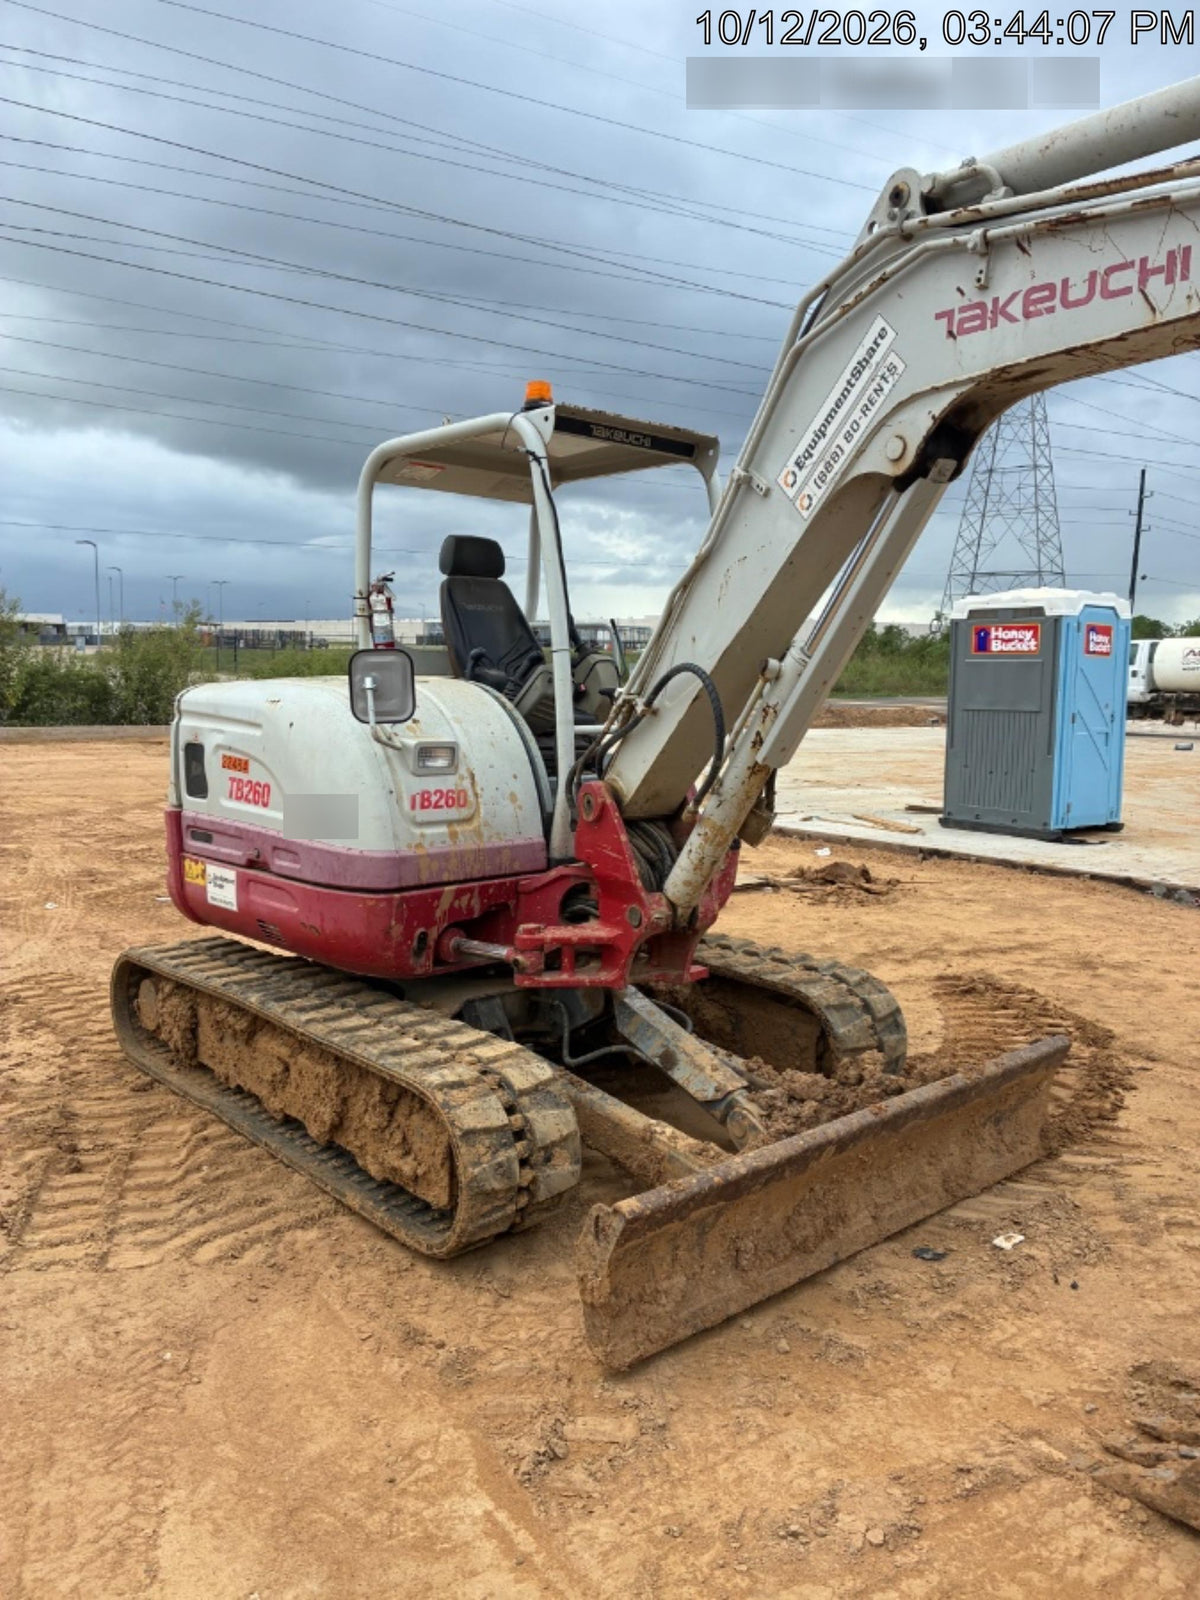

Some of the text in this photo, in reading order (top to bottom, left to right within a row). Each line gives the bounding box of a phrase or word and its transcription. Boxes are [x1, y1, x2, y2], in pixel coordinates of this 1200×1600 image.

[793, 326, 889, 471] EquipmentShare
[813, 361, 898, 490] (888) 80-RENTS
[991, 626, 1034, 641] Honey
[991, 639, 1037, 652] Bucket
[228, 776, 271, 808] TB260
